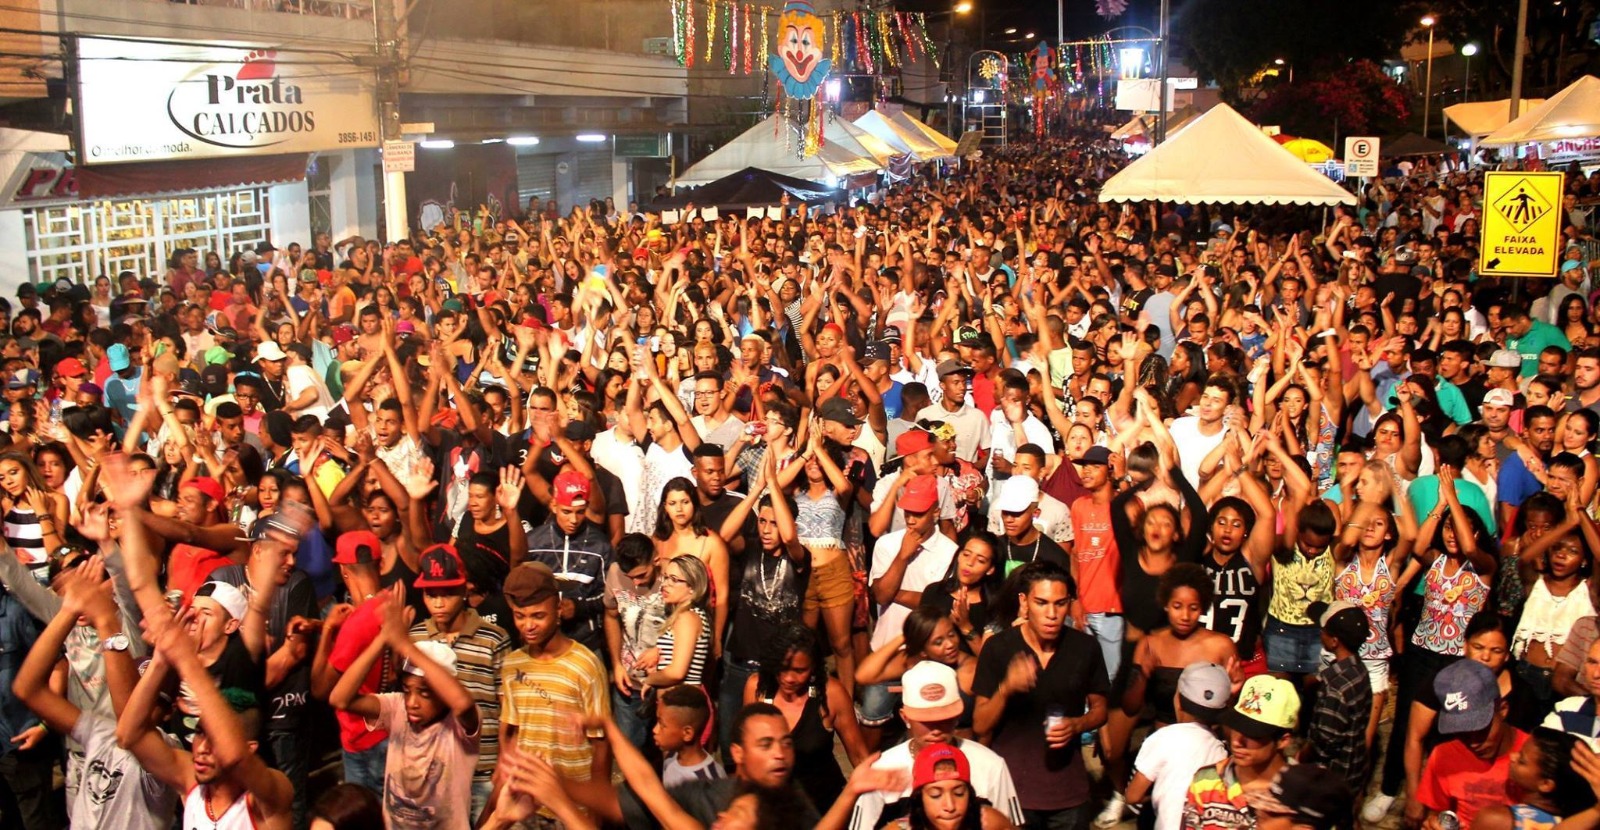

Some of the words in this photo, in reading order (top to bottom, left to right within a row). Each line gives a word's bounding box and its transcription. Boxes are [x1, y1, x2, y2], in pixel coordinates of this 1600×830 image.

[206, 74, 303, 104] Prata
[193, 110, 315, 141] CALÇADOS
[338, 131, 377, 143] 3856-1451
[1358, 144, 1366, 154] E
[1504, 235, 1536, 244] FAIXA
[1494, 246, 1545, 255] ELEVADA
